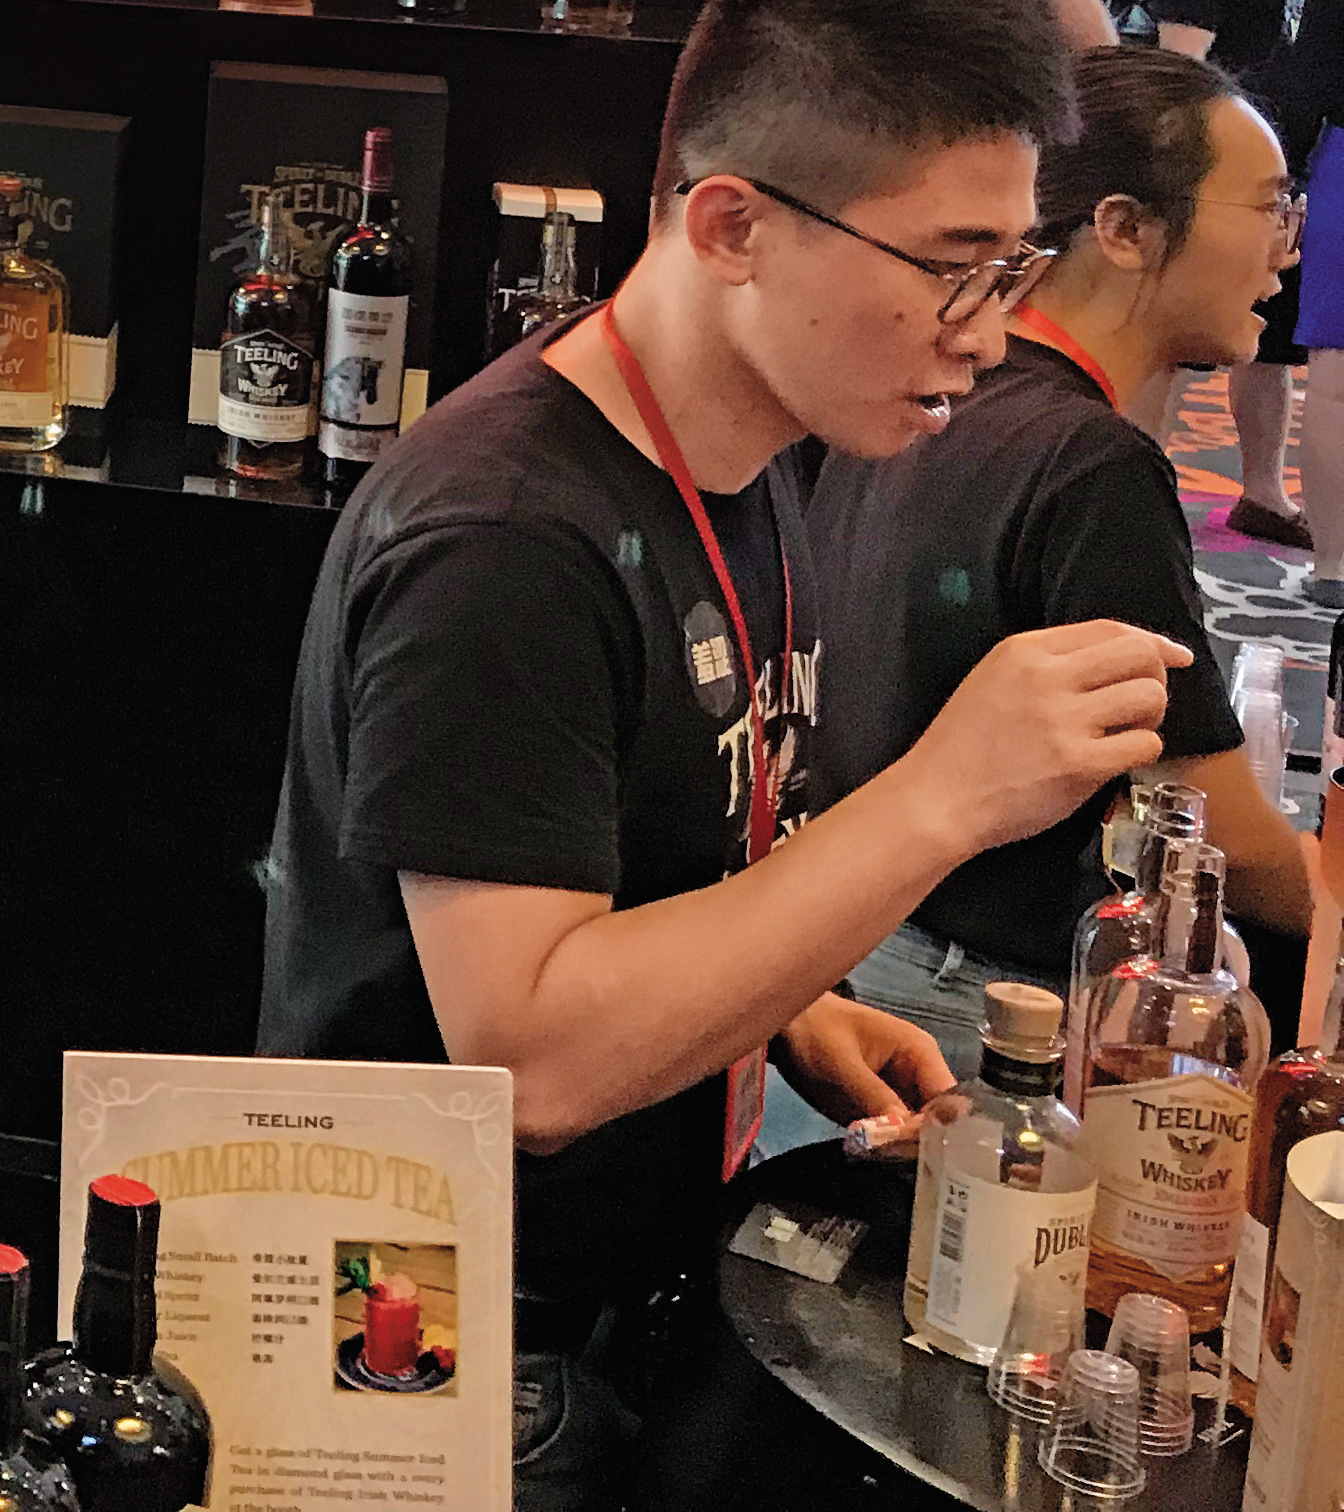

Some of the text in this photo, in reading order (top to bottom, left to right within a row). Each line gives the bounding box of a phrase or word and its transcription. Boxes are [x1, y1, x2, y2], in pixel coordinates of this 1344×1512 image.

[234, 344, 299, 370] TEELING
[243, 1112, 334, 1130] TEELING
[1132, 1099, 1248, 1142] TEELING
[288, 1141, 379, 1200] ICED
[386, 1155, 457, 1226] TEA
[1140, 1159, 1232, 1192] WHISKEY
